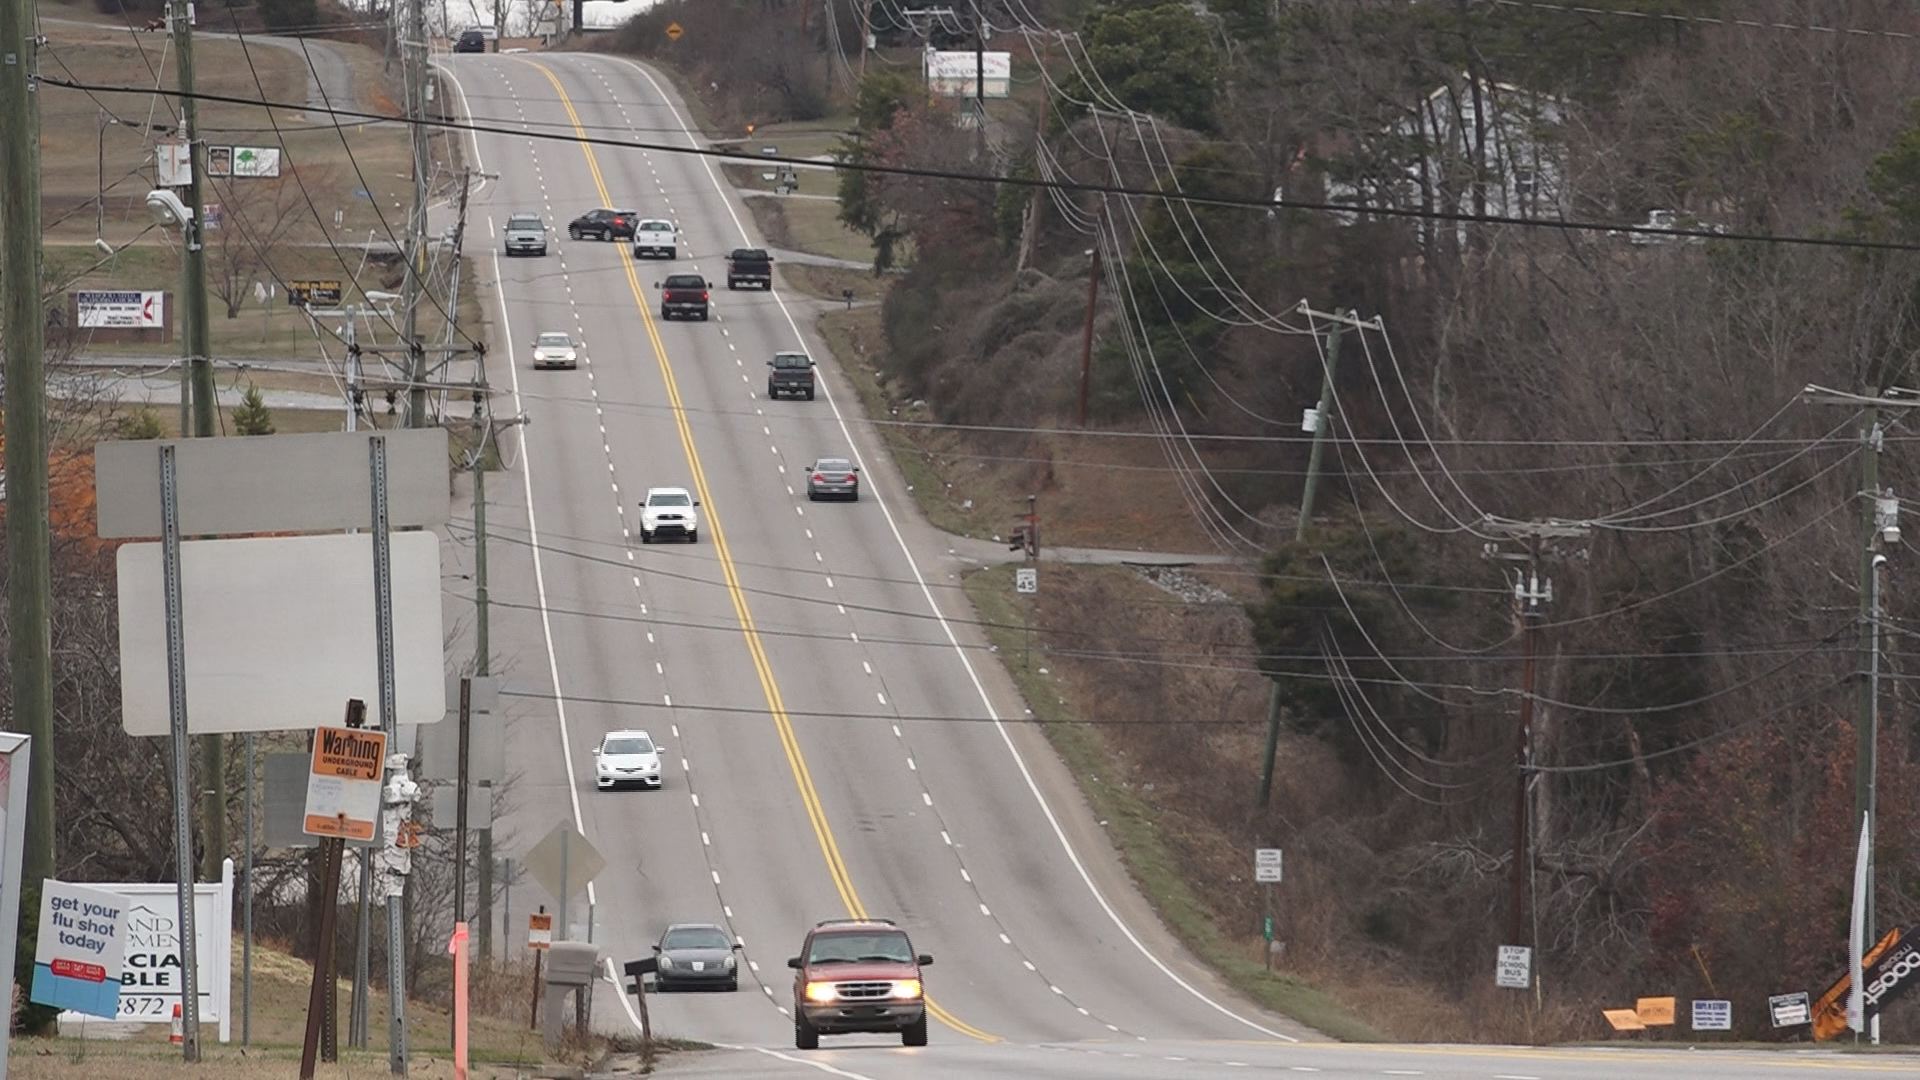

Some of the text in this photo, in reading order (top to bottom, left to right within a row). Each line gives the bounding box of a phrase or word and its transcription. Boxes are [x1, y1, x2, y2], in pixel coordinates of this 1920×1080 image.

[1018, 580, 1035, 590] 45
[322, 756, 374, 769] UNDERGROUND
[323, 729, 381, 779] Warning
[51, 896, 120, 919] get your
[53, 912, 115, 937] flu shot
[59, 931, 106, 954] today
[1498, 961, 1528, 969] SCHOOL
[1504, 968, 1522, 976] BUS
